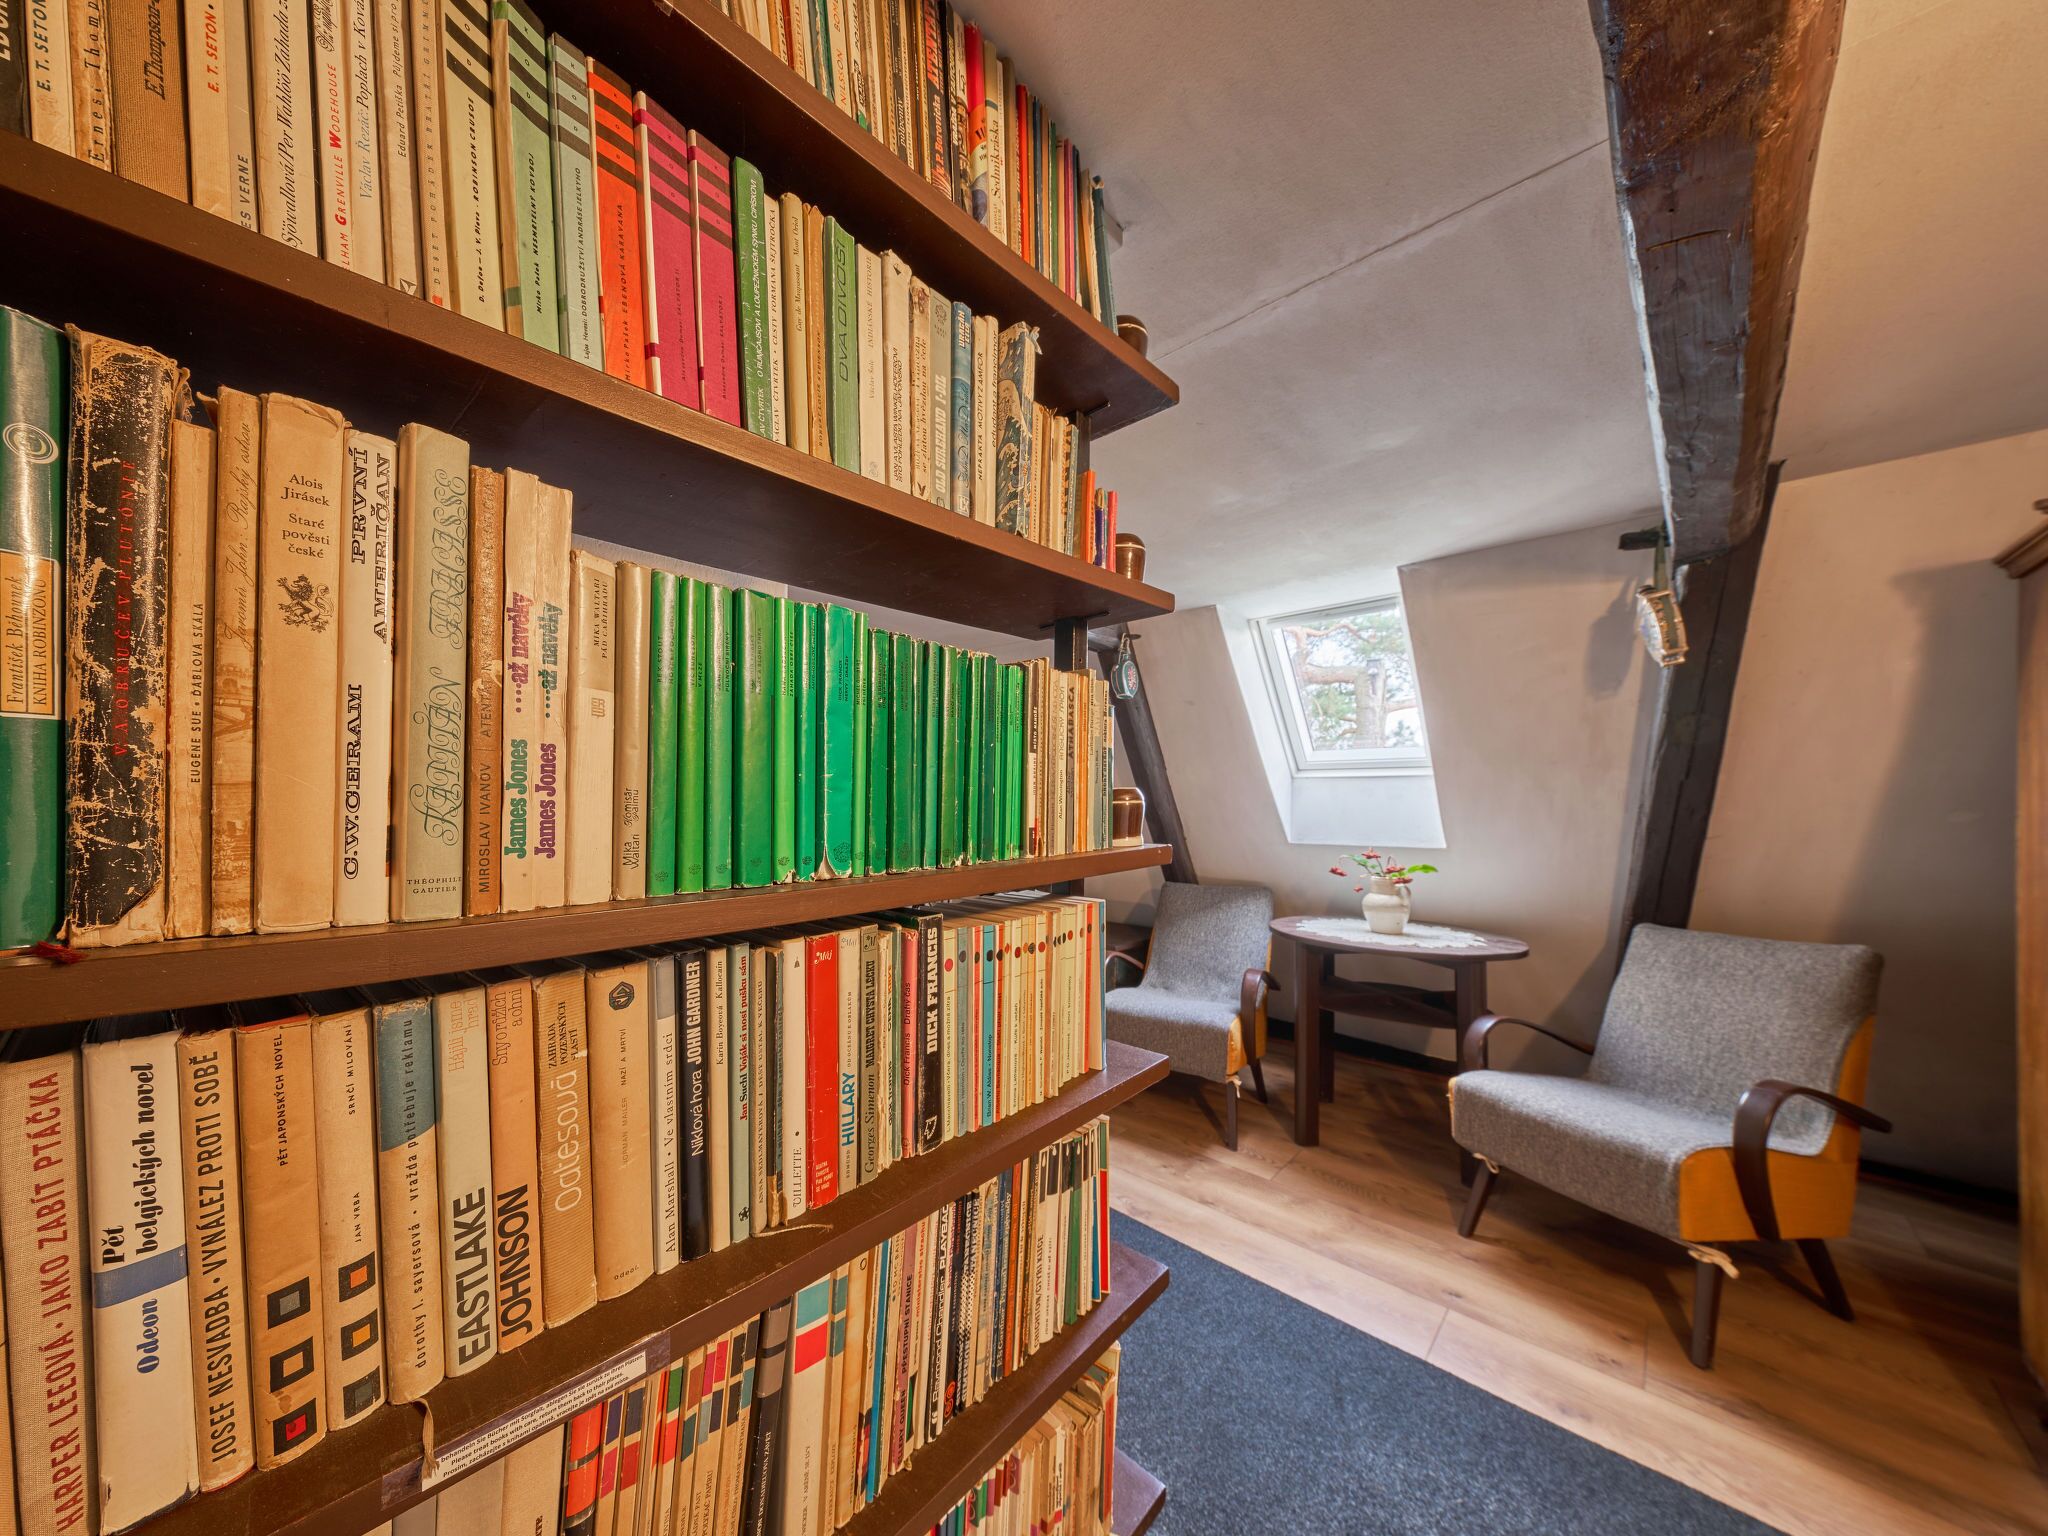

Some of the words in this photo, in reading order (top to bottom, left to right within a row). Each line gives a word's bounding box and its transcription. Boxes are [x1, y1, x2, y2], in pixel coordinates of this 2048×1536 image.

[205, 11, 218, 60] SETON
[389, 3, 400, 23] pro
[390, 24, 399, 33] si
[36, 59, 49, 72] T.
[274, 14, 290, 72] Záhada
[37, 80, 50, 91] E.
[207, 65, 218, 75] T.
[208, 83, 219, 93] E.
[356, 54, 369, 109] Poplach
[275, 72, 292, 129] Wahlöö
[326, 63, 341, 148] WODEHOUSE
[394, 85, 405, 119] Petiška
[467, 96, 476, 140] CRUSOE
[395, 123, 407, 157] Eduard
[989, 119, 1001, 198] Sedmikráska
[237, 154, 250, 204] VERNE
[333, 155, 347, 225] GRENVILLE
[359, 157, 372, 200] Václav
[470, 144, 479, 201] ROBINSON
[528, 152, 537, 193] KOVBOJ
[574, 167, 583, 206] JELKYHO
[616, 204, 625, 261] KARAVANA
[838, 332, 848, 381] DVA
[234, 423, 250, 464] ostrov
[280, 487, 330, 505] Jirásek
[288, 474, 323, 490] Alois
[349, 448, 368, 564] PRVNÍ
[936, 471, 946, 493] OLD
[282, 530, 330, 546] pověsti
[288, 513, 325, 530] Staré
[288, 545, 324, 559] české
[370, 454, 390, 643] AMERIČAN
[6, 643, 23, 704] František
[32, 662, 47, 706] KNIHA
[190, 711, 202, 733] SUE
[190, 737, 203, 784] EUGENE
[506, 739, 528, 795] Jones
[536, 743, 557, 797] Jones
[480, 763, 492, 815] IVANOV
[505, 798, 528, 859] James
[535, 801, 556, 859] James
[479, 822, 491, 893] MIROSLAV
[623, 841, 632, 866] Mika
[714, 961, 724, 999] Kallocain
[927, 927, 937, 1004] FRANCIS
[509, 988, 522, 1019] ohni
[686, 961, 701, 1025] GARDNER
[739, 979, 749, 1008] pušku
[739, 1010, 747, 1031] nosí
[740, 1034, 747, 1042] si
[927, 1008, 938, 1054] DICK
[273, 1033, 284, 1070] NOVEL
[401, 1019, 415, 1075] reklamu
[493, 1041, 509, 1065] Sny
[547, 1024, 557, 1068] ZAHRADA
[663, 1032, 673, 1065] srdci
[687, 1027, 702, 1065] JOHN
[715, 1043, 724, 1065] Karin
[739, 1044, 748, 1071] Voják
[865, 1026, 875, 1068] MAIGRET
[130, 1063, 154, 1124] novel
[188, 1051, 219, 1105] SOBĚ
[663, 1070, 674, 1124] vlastním
[691, 1070, 703, 1102] hora
[739, 1073, 748, 1102] Suchl
[864, 1074, 876, 1123] Simenon
[903, 1066, 911, 1085] Dick
[25, 1072, 61, 1171] PTÁČKA
[273, 1073, 288, 1145] JAPONSKÝCH
[402, 1080, 421, 1149] potřebuje
[691, 1105, 704, 1155] Niklová
[740, 1103, 748, 1121] Jan
[842, 1072, 855, 1146] HILLARY
[194, 1113, 223, 1176] PROTI
[277, 1147, 288, 1166] PĚT
[664, 1127, 674, 1146] Ve
[865, 1124, 877, 1173] Georges
[132, 1129, 162, 1254] belgických
[406, 1155, 420, 1201] vražda
[664, 1162, 675, 1218] Marshall
[30, 1180, 68, 1249] ZABÍT
[195, 1179, 228, 1275] VYNÁLEZ
[353, 1192, 361, 1219] VRBA
[101, 1226, 126, 1265] Pět
[353, 1222, 362, 1243] JAN
[664, 1222, 676, 1253] Alan
[939, 1205, 949, 1270] PLAYBAC
[407, 1223, 424, 1293] sayersová
[453, 1187, 492, 1366] EASTLAKE
[496, 1184, 533, 1337] JOHNSON
[39, 1255, 71, 1316] JAKO
[136, 1299, 159, 1374] Odeon
[202, 1288, 233, 1396] NESVADBA
[412, 1313, 428, 1368] dorothy
[39, 1331, 77, 1427] LEEOVÁ
[207, 1399, 237, 1462] JOSEF
[49, 1433, 85, 1532] HARPER
